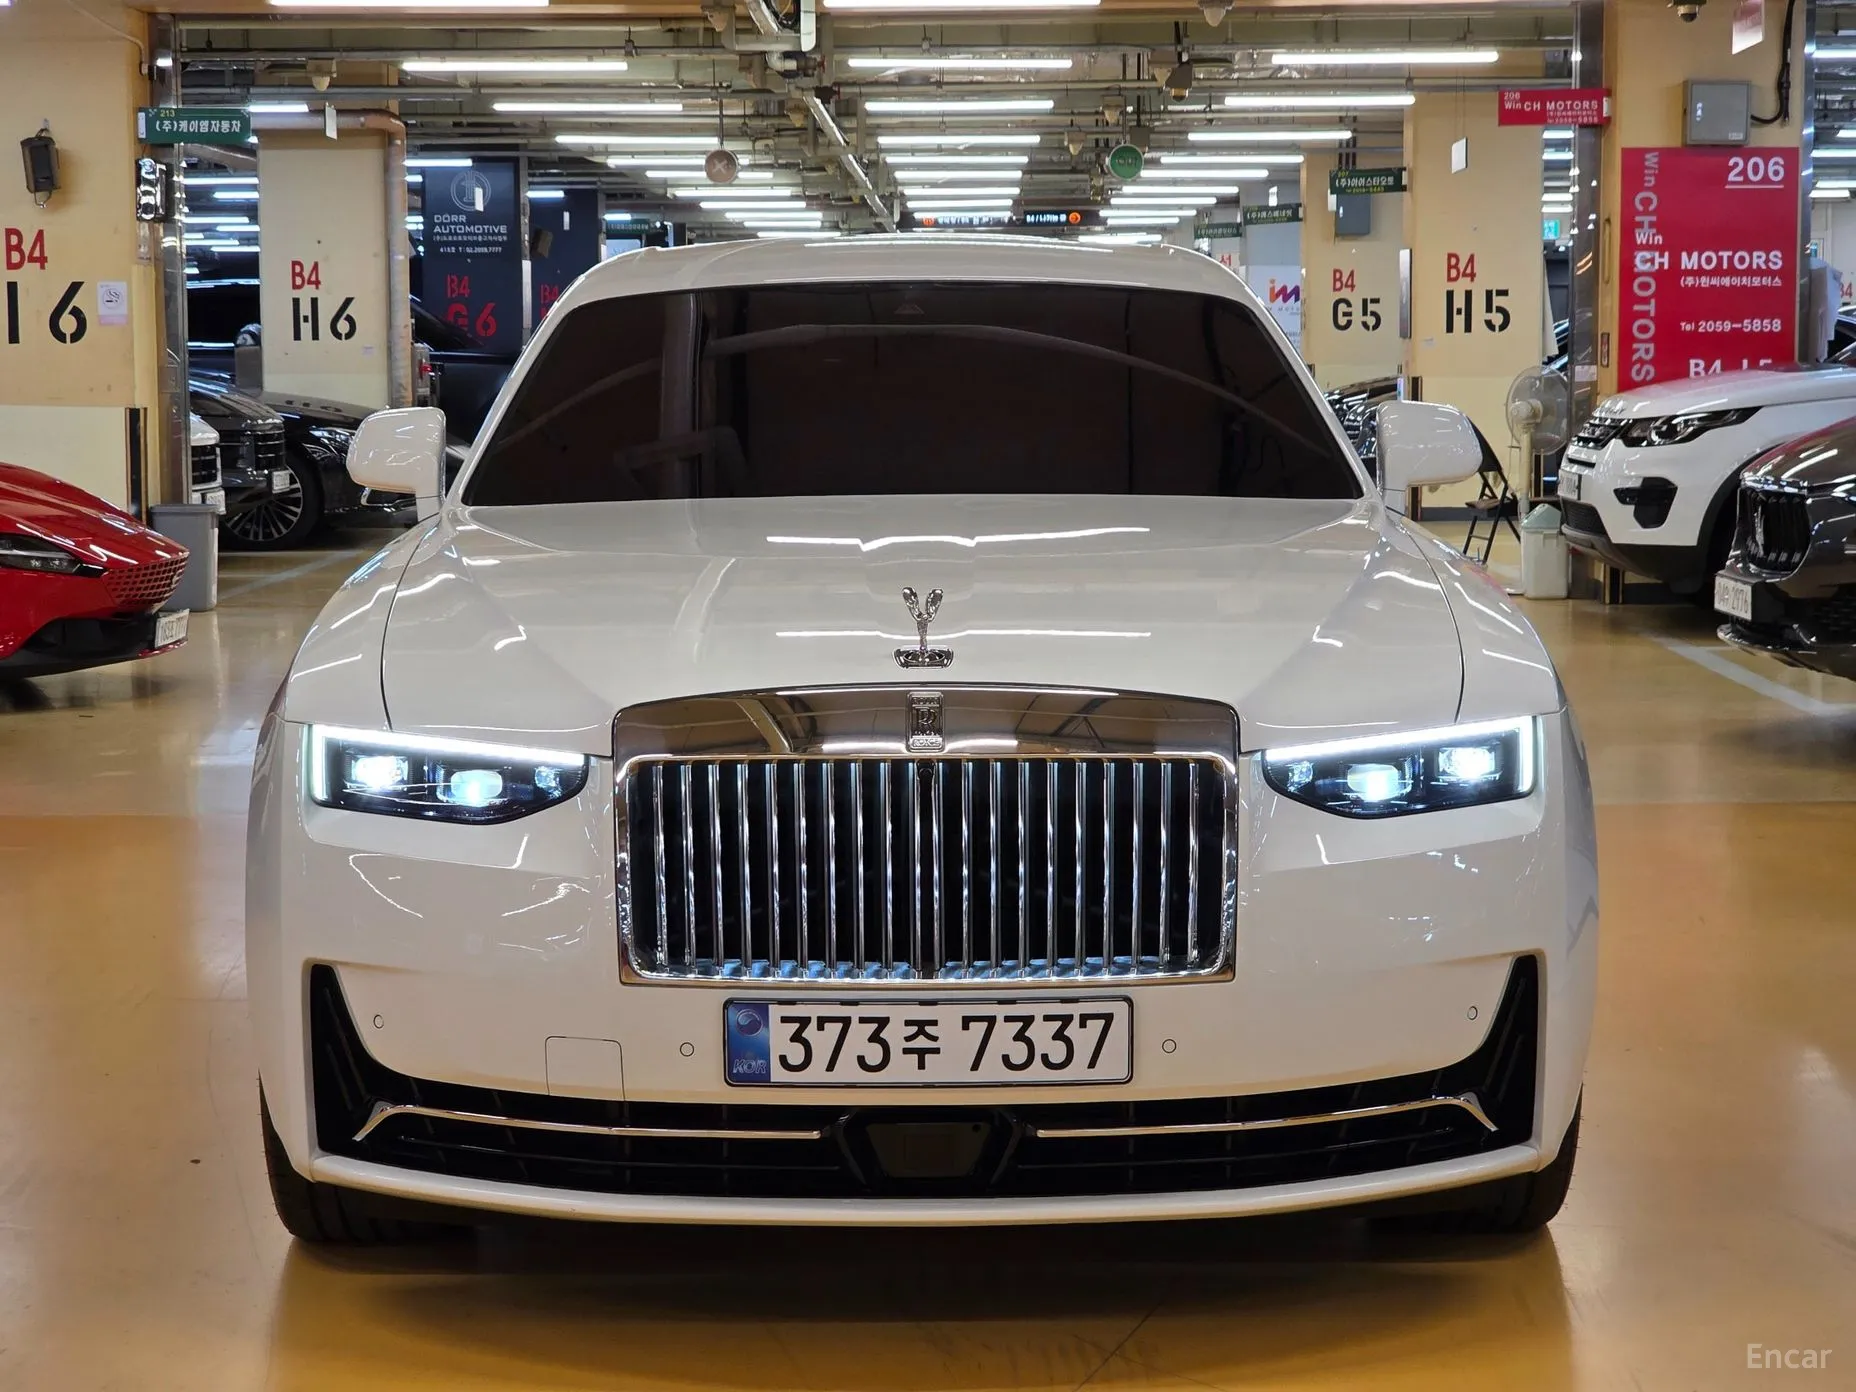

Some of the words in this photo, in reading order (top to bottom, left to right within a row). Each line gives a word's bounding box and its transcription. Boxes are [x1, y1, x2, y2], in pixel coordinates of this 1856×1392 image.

[1503, 92, 1521, 100] 206
[1504, 101, 1521, 110] Win
[1523, 102, 1541, 111] CH
[1546, 100, 1598, 111] MOTORS
[160, 109, 176, 118] 213
[1644, 152, 1659, 187] Win
[1727, 156, 1785, 182] 206
[433, 225, 508, 234] AUTOMOTIVE
[1635, 232, 1663, 245] Win
[4, 227, 49, 271] B4
[1446, 252, 1477, 283] B4
[1635, 251, 1670, 271] CH
[1680, 251, 1783, 271] MOTORS
[291, 260, 322, 291] B4
[1332, 268, 1356, 292] B4
[447, 274, 471, 298] B4
[540, 284, 560, 304] B4
[1680, 322, 1695, 332] Tel
[1698, 318, 1782, 332] 2059-5858
[778, 1014, 941, 1073] 373주
[961, 1012, 1115, 1072] 7337
[732, 1058, 768, 1074] KOR
